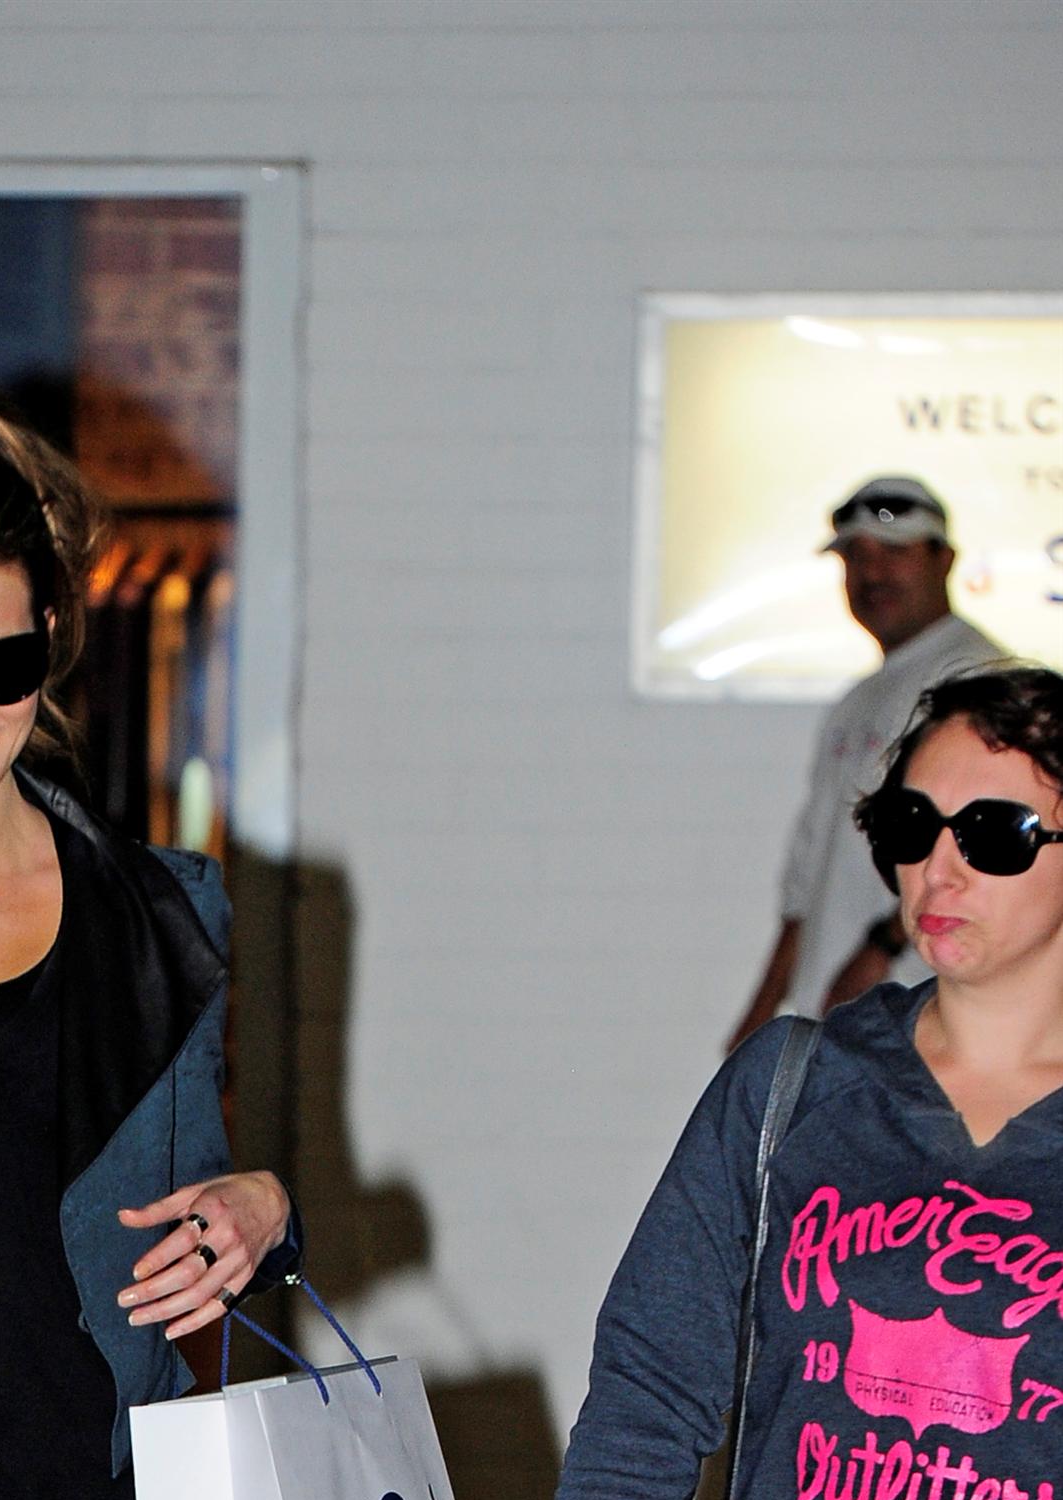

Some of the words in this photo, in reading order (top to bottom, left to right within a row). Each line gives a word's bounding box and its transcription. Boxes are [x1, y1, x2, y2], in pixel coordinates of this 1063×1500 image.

[803, 1340, 839, 1383] 19
[1016, 1378, 1063, 1422] 77
[854, 1381, 914, 1407] PHYSICAL
